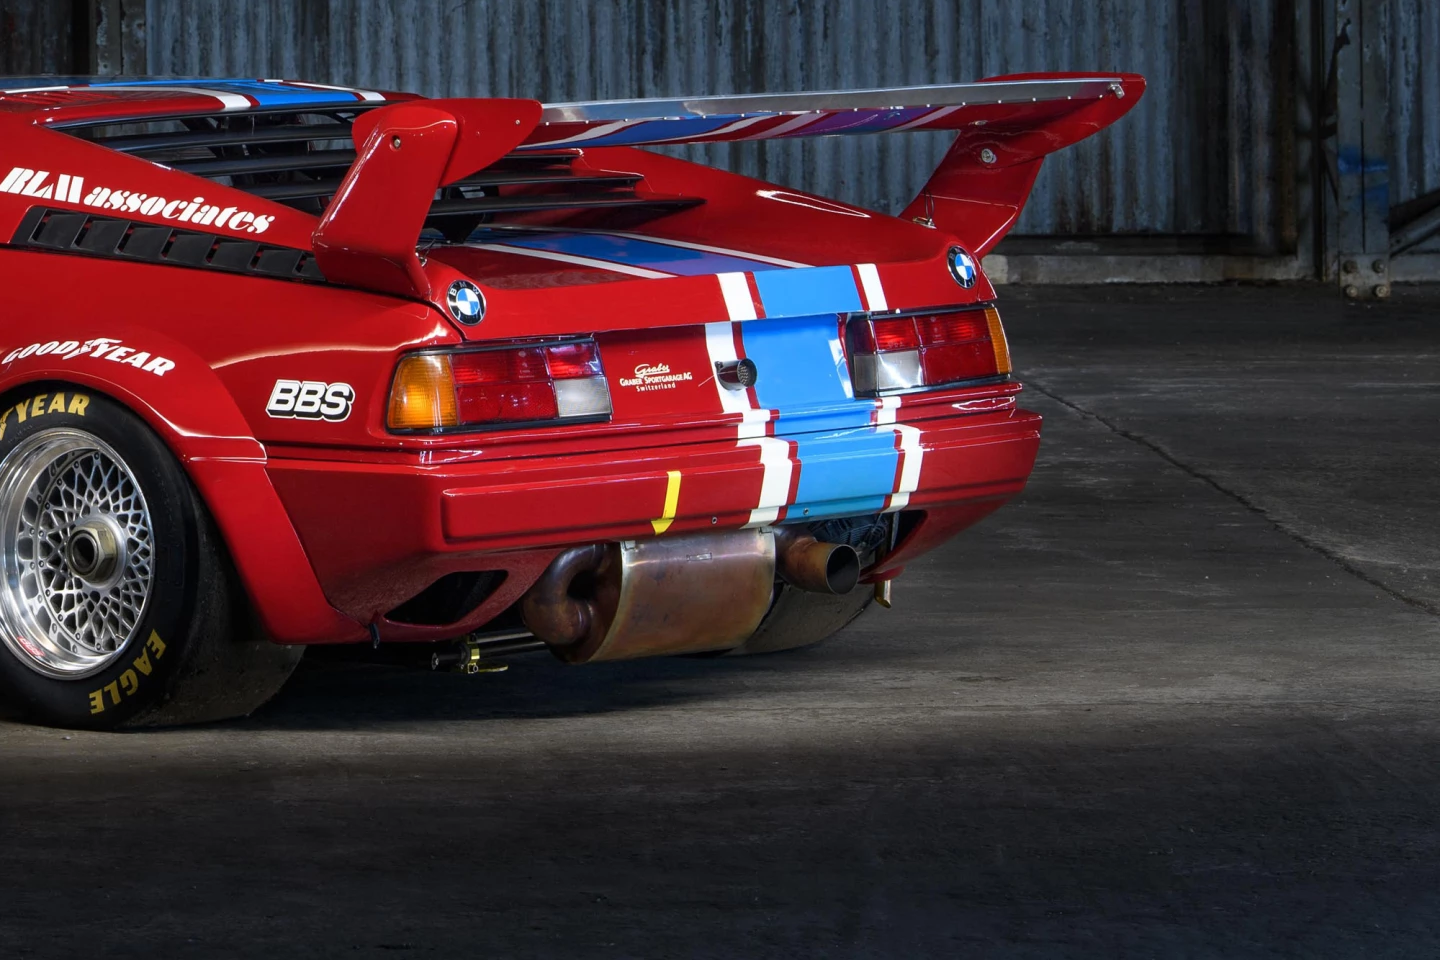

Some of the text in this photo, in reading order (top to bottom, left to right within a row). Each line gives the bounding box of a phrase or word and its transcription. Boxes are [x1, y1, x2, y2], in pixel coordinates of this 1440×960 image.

[83, 186, 275, 234] associates
[449, 281, 480, 296] BMW
[1, 338, 176, 377] GOODYEAR
[683, 372, 693, 380] AG
[266, 379, 356, 422] BBS
[636, 382, 676, 392] Switzerland
[89, 629, 166, 715] EAGLE
